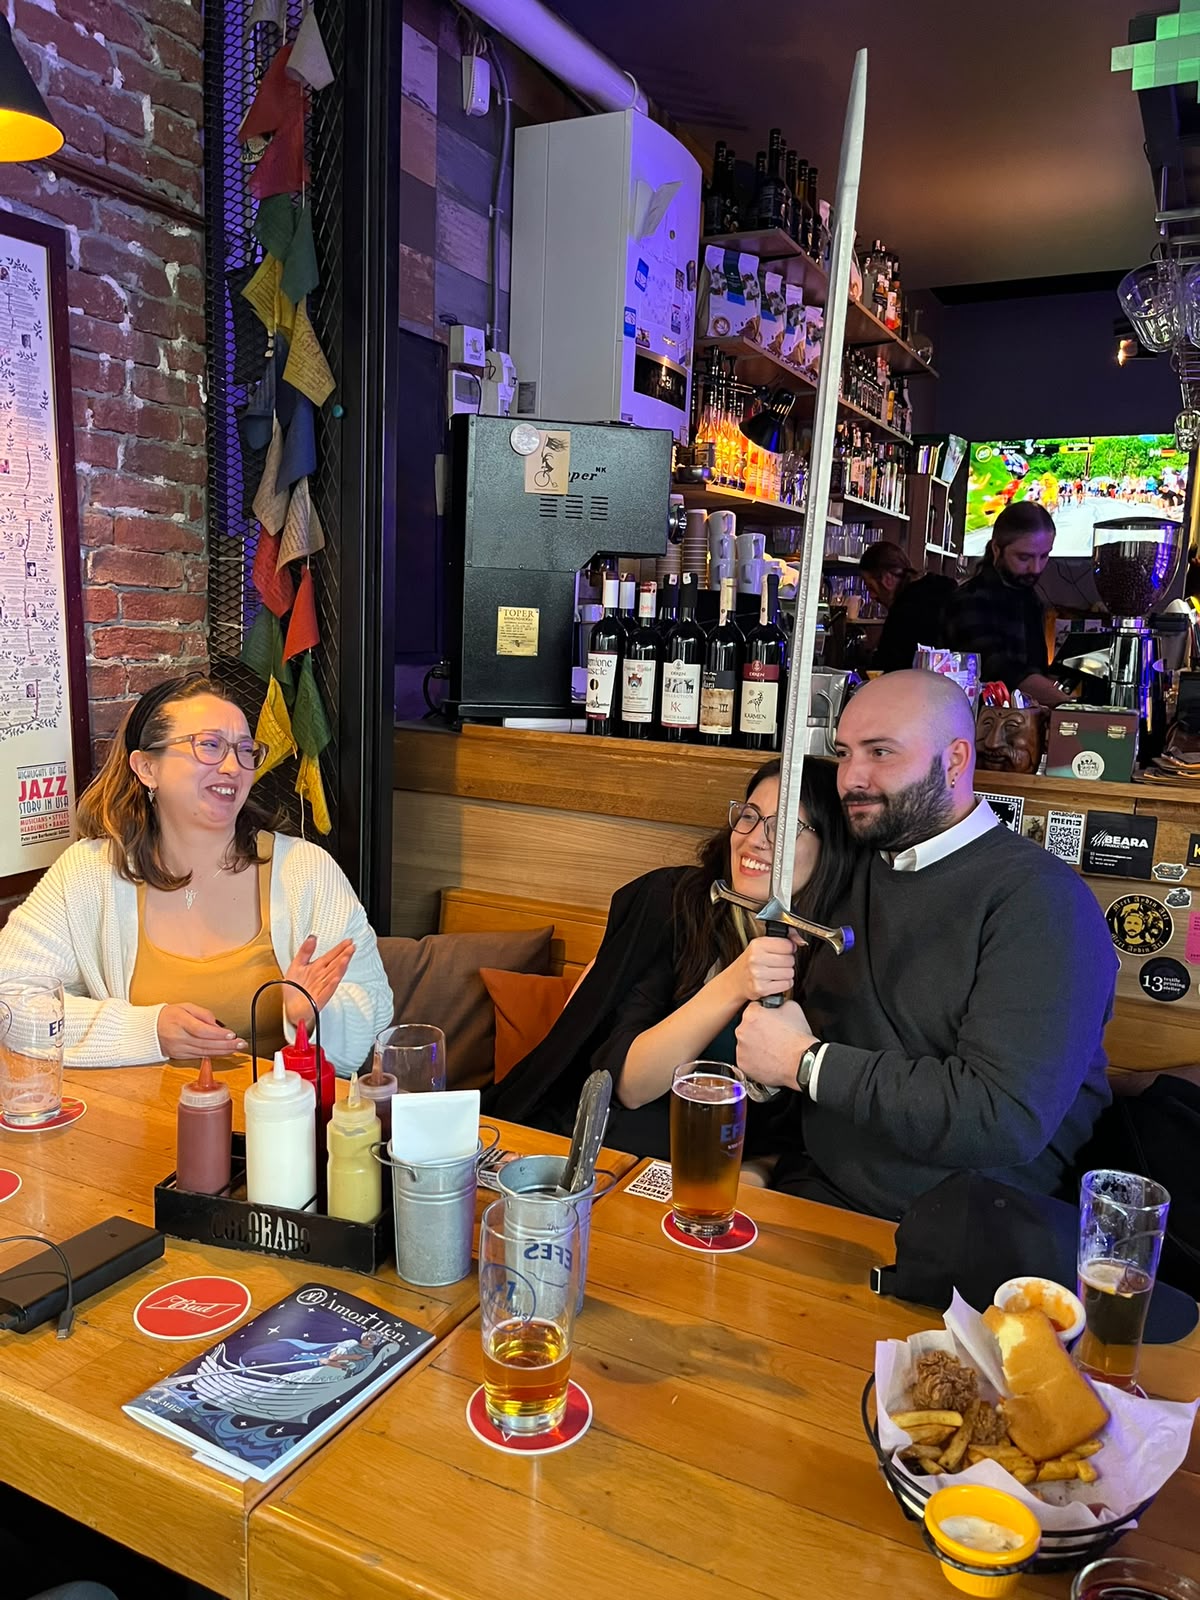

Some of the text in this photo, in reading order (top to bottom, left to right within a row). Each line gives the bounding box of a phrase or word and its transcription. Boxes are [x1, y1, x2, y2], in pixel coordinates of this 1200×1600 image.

[503, 609, 534, 618] TOPER
[18, 765, 67, 779] HIGHLIGHTS OF THE
[18, 775, 68, 802] JAZZ
[19, 795, 69, 814] STORY IN USA
[20, 812, 70, 826] MUSICIANS STYLES
[20, 819, 70, 833] HEADLINES BANDS
[1105, 835, 1149, 848] BEARA
[1143, 975, 1164, 992] 13
[1163, 981, 1186, 989] printing
[210, 1211, 311, 1254] COLORADO
[168, 1296, 215, 1314] Bud
[321, 1299, 406, 1342] Amon Hen
